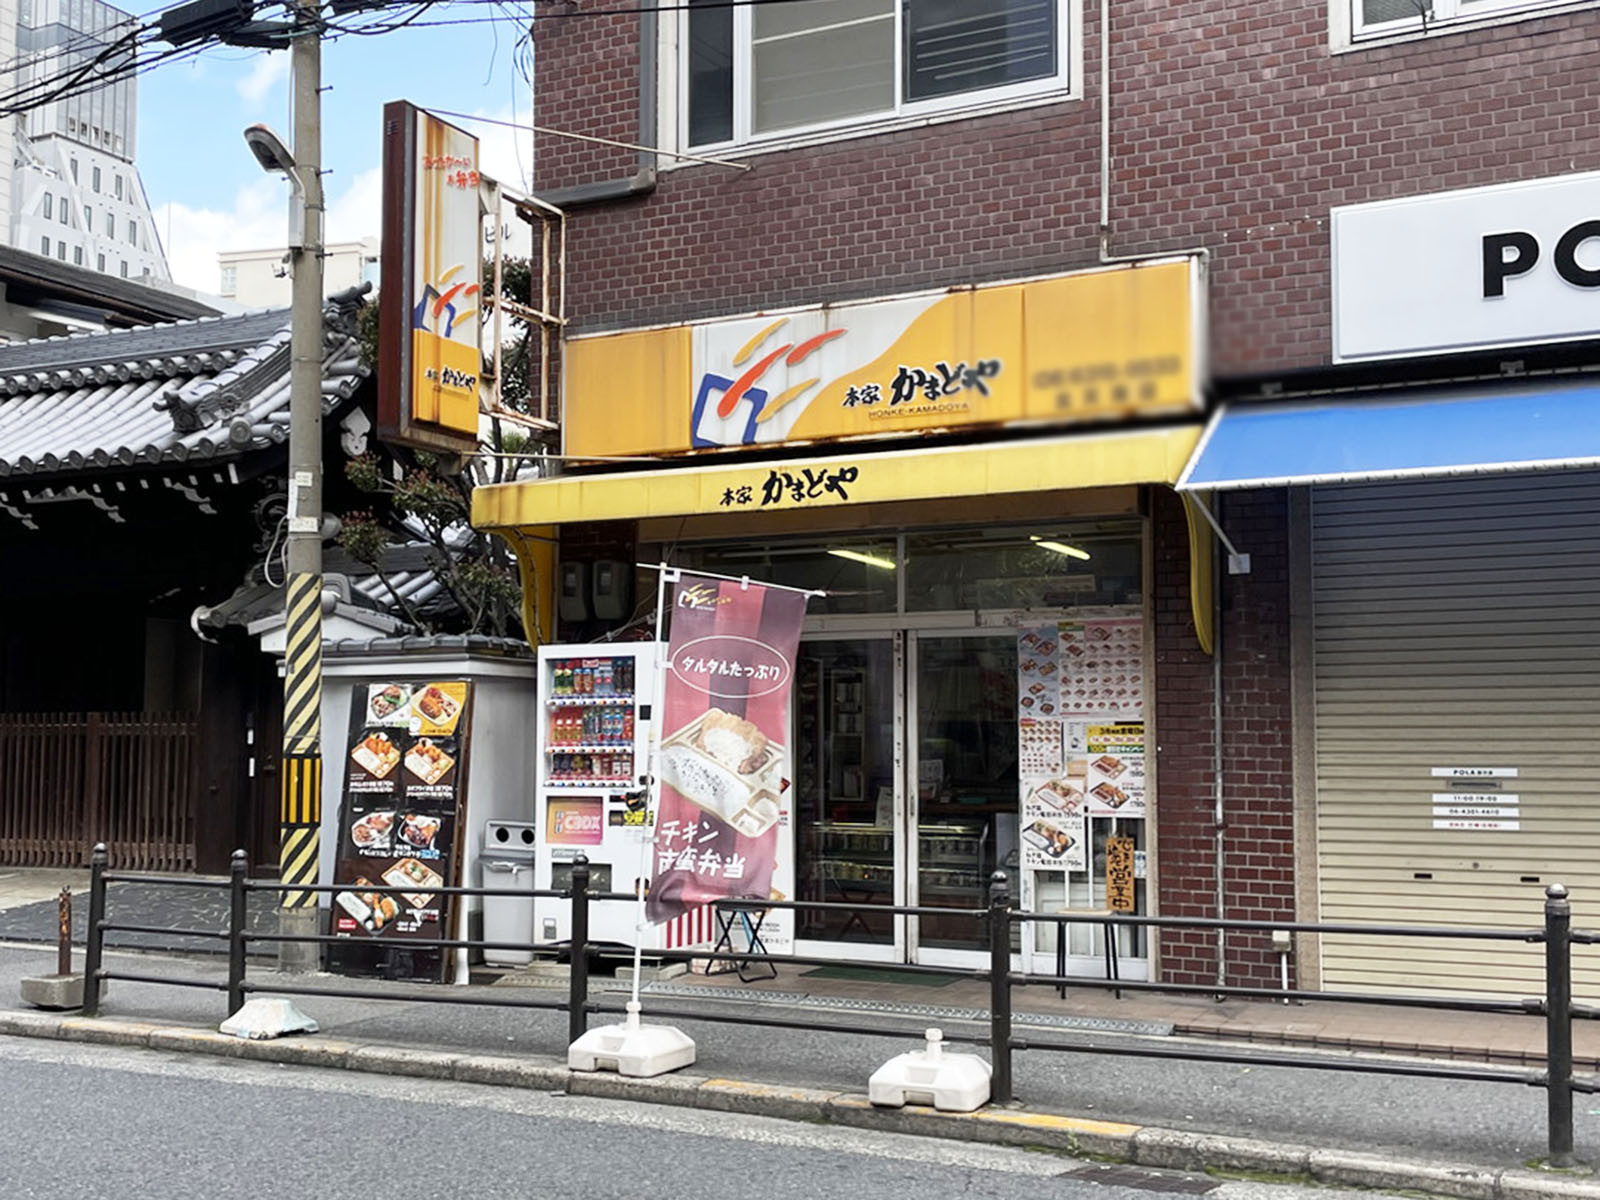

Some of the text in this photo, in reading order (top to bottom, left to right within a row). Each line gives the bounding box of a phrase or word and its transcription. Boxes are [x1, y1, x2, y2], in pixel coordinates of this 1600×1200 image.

[1483, 220, 1600, 298] PO
[842, 385, 880, 408] 本家
[890, 359, 1001, 405] かまどや
[719, 466, 859, 508] 本家 かまどや
[682, 656, 780, 681] タルタルたっぷり
[660, 819, 719, 846] チキン
